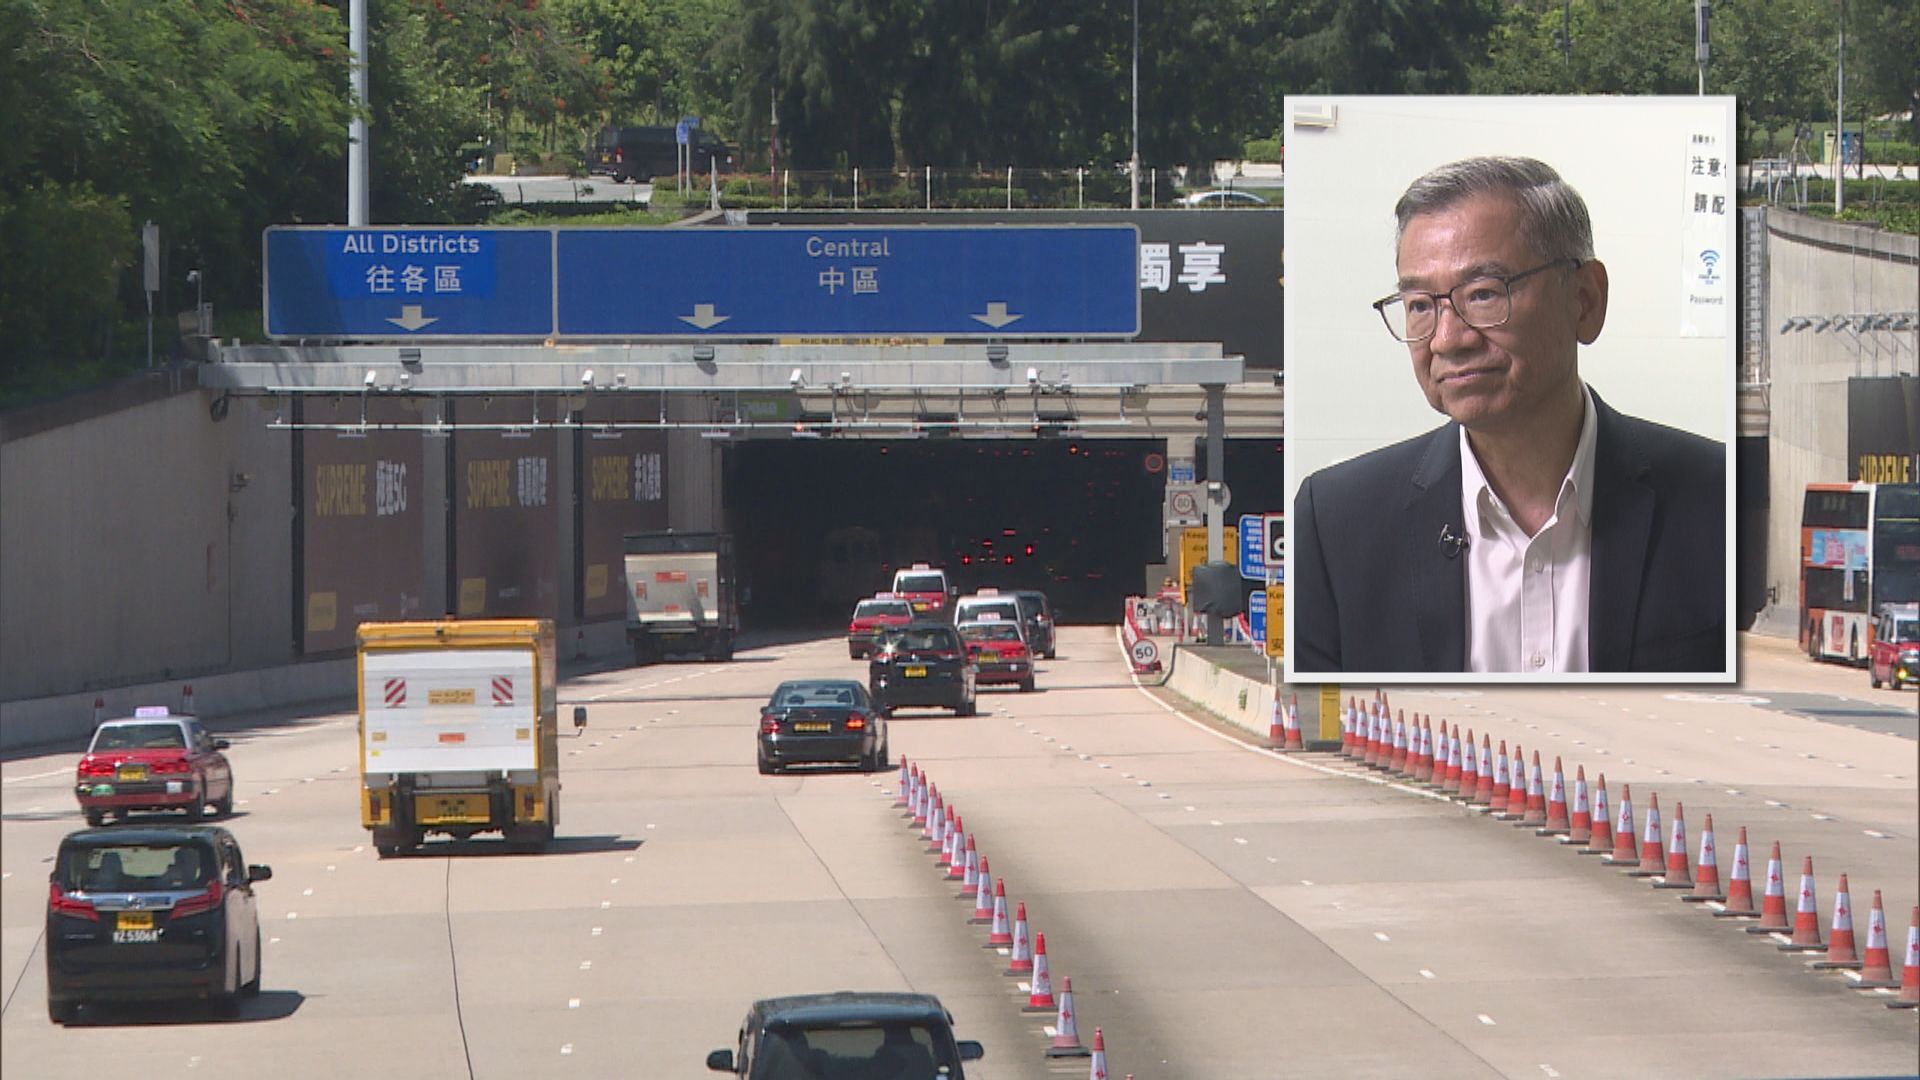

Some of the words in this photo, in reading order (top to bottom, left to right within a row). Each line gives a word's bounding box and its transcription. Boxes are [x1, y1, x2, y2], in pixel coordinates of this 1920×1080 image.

[1691, 155, 1726, 178] 注意
[343, 234, 375, 254] All
[383, 234, 480, 254] Districts
[806, 236, 890, 258] Central
[365, 264, 462, 294] 往各區
[818, 266, 879, 296] 中區
[316, 464, 367, 516] SUPREME
[467, 459, 510, 509] SUPREME
[592, 455, 629, 501] SUPREME
[1135, 646, 1153, 659] 50
